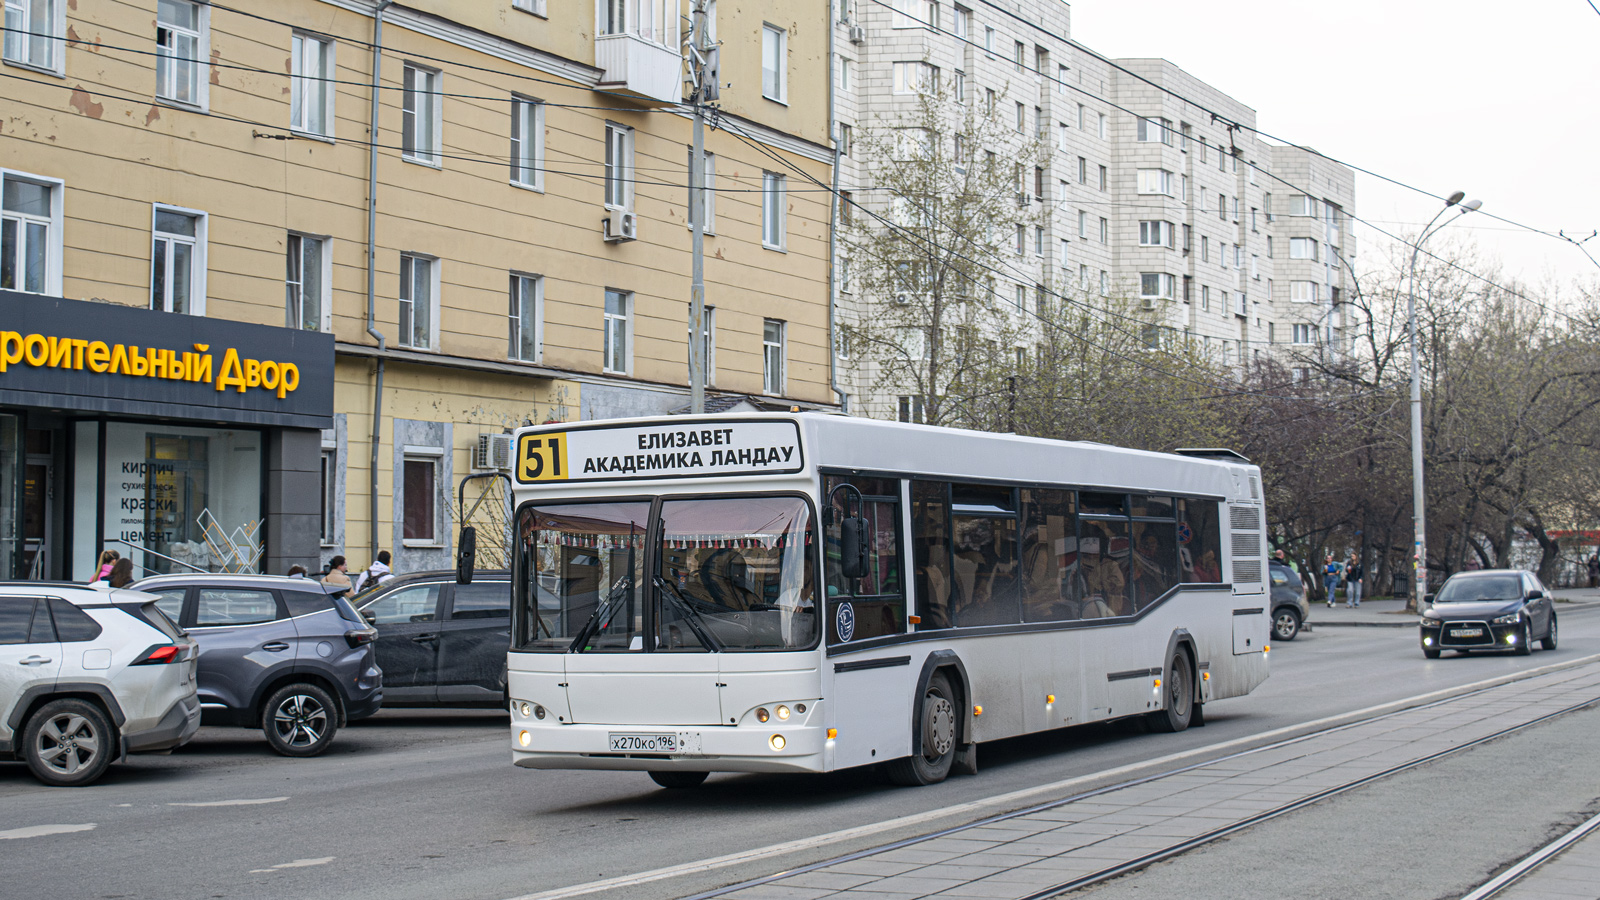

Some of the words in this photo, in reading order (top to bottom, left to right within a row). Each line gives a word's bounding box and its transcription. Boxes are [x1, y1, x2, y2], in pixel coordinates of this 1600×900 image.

[0, 330, 212, 383] роительный
[216, 348, 300, 399] Двор
[637, 428, 734, 450] ЕЛИЗАВЕТ
[525, 438, 561, 478] 51
[583, 451, 703, 474] АКАДЕМИКА
[709, 446, 794, 467] ЛАНДАУ
[122, 462, 174, 478] кирпич
[121, 482, 146, 492] сухие
[121, 497, 173, 513] краски
[121, 531, 173, 542] цемент
[657, 736, 673, 746] 196
